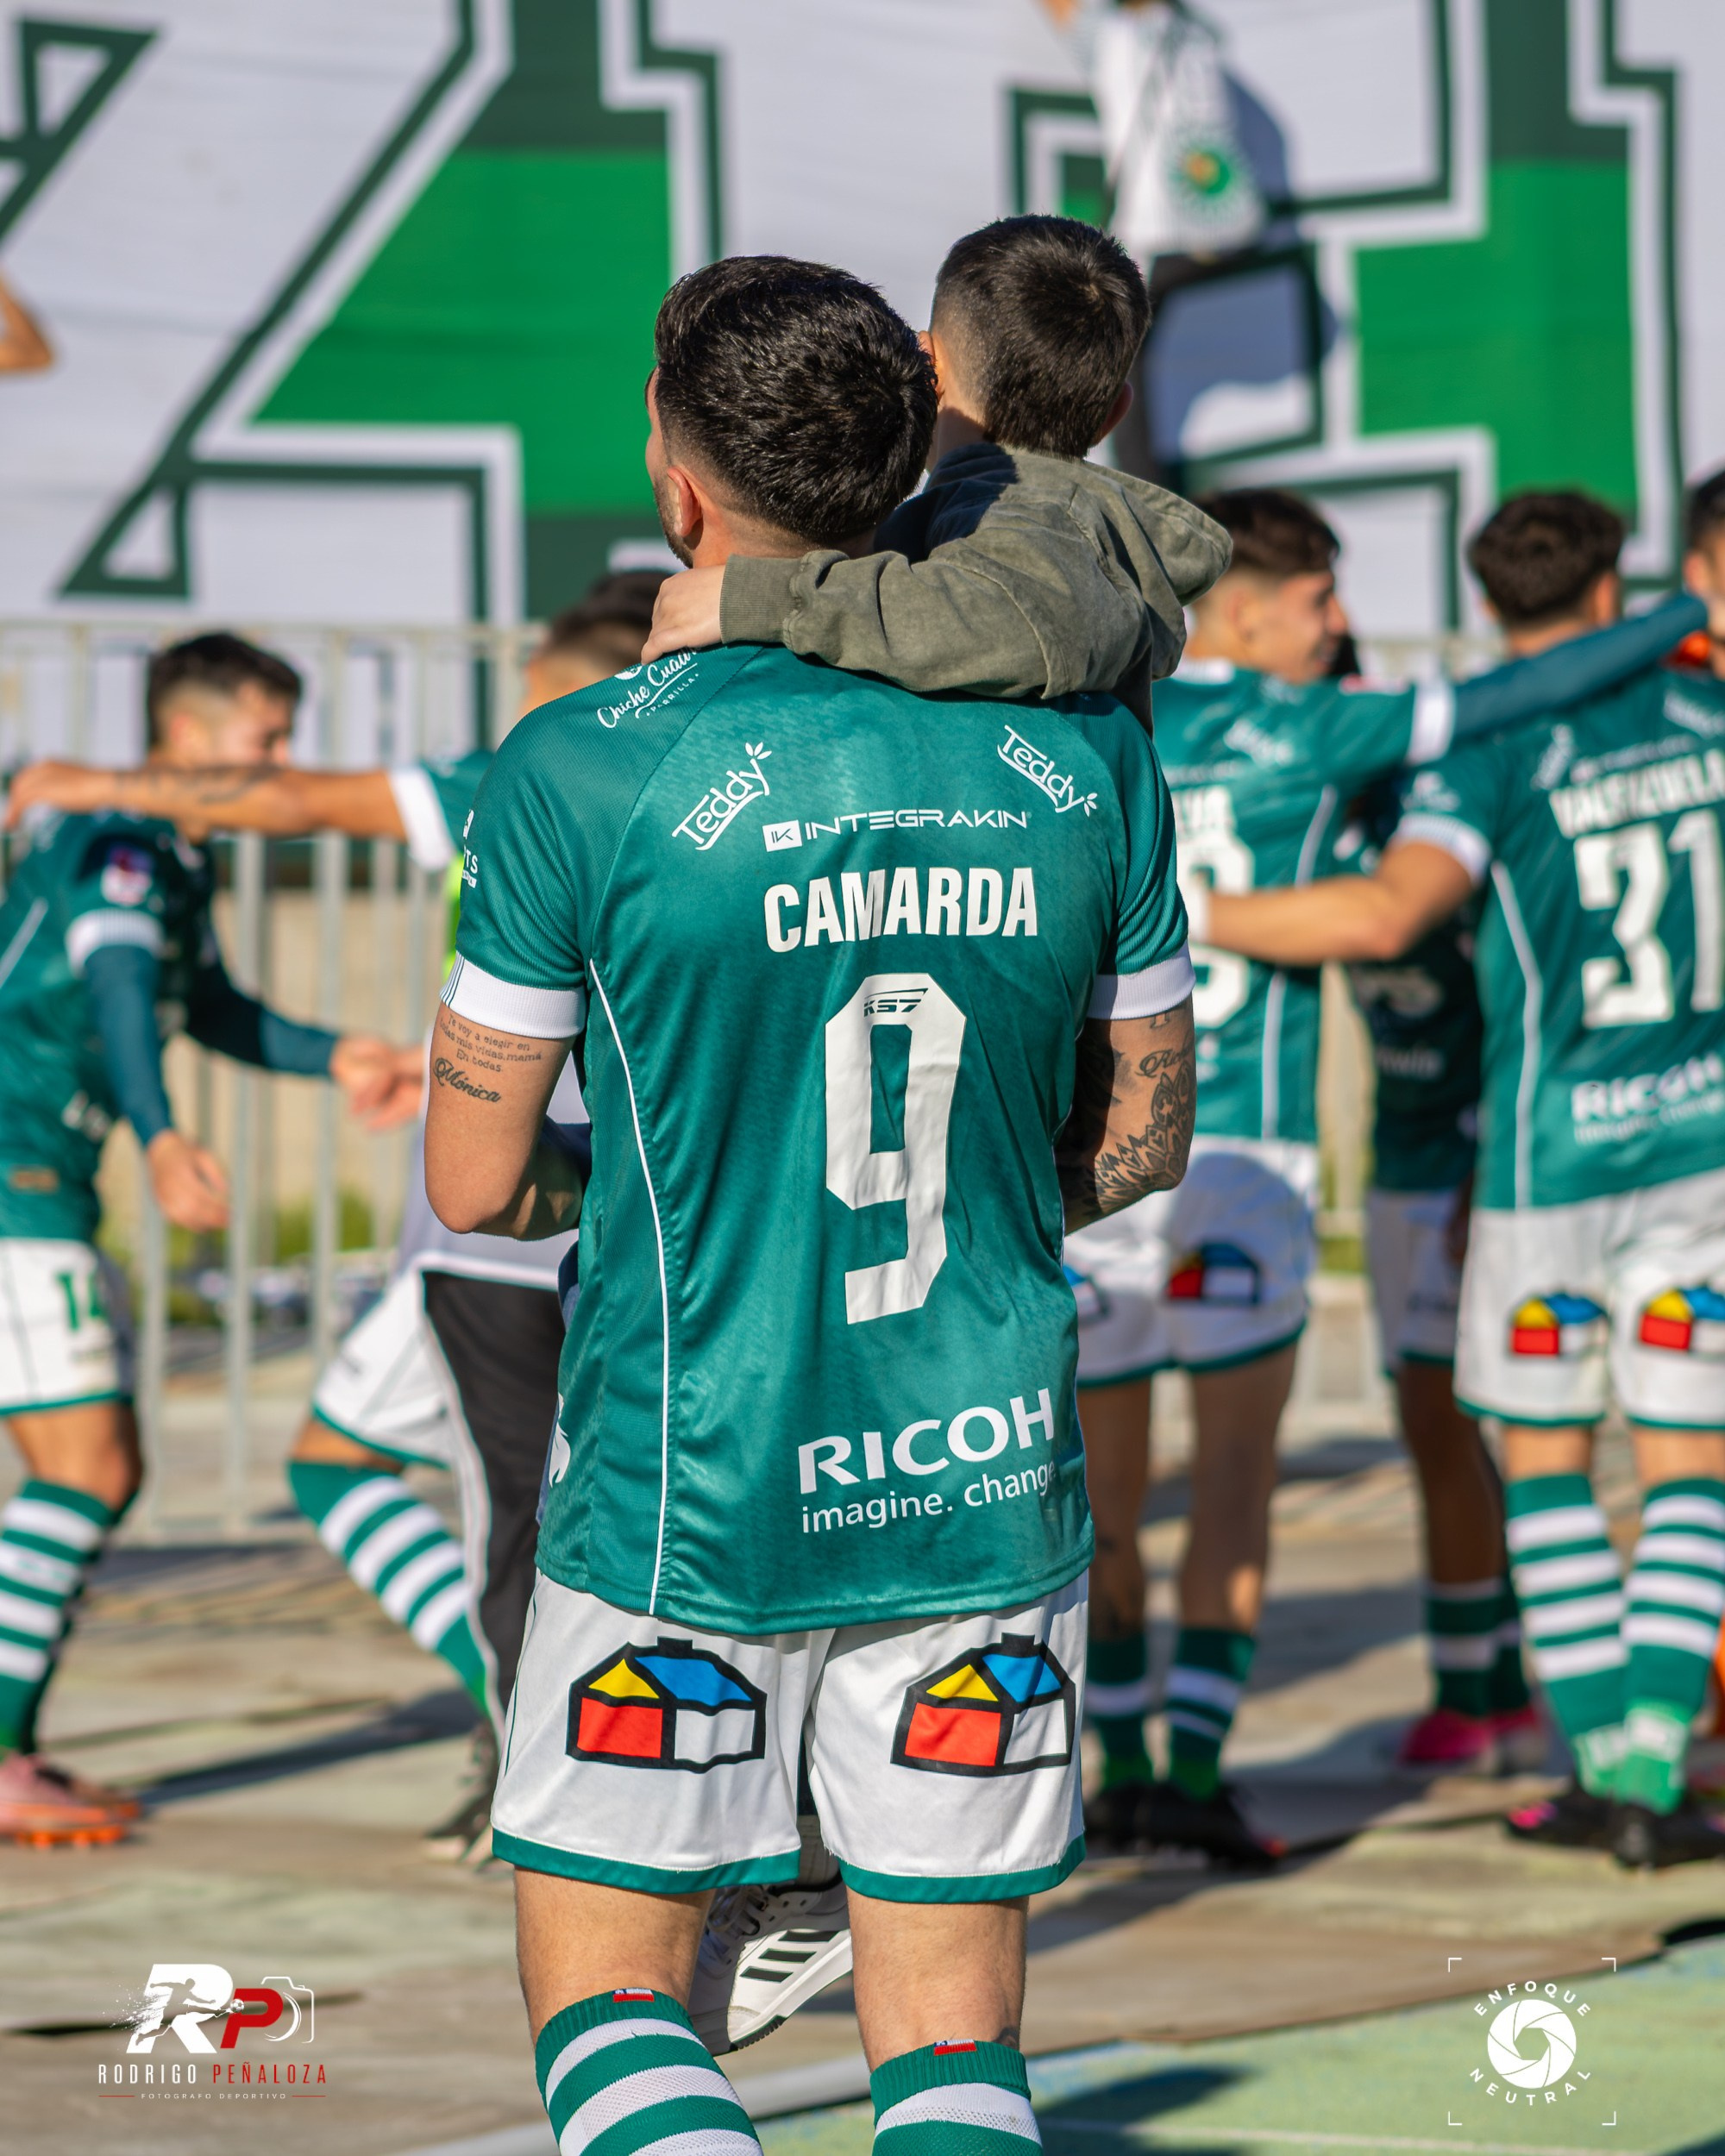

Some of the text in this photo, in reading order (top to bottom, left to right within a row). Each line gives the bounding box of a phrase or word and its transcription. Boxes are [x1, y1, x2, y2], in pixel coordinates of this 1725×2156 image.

[597, 686, 650, 729] Chiche
[1001, 724, 1085, 813] Teddy
[671, 757, 771, 846] Teddy
[805, 809, 1027, 840] INTEGRAKIN
[764, 867, 1038, 953] CAMARDA
[1572, 807, 1724, 1029] 31
[863, 999, 922, 1018] KS7
[448, 1013, 456, 1026] Te
[458, 1022, 472, 1037] voy
[484, 1036, 513, 1050] elegir
[517, 1042, 530, 1051] en
[456, 1037, 473, 1050] mis
[456, 1048, 503, 1072] En todas
[825, 973, 967, 1325] 9
[798, 1388, 1054, 1495] RICOH
[802, 1490, 953, 1533] imagine.
